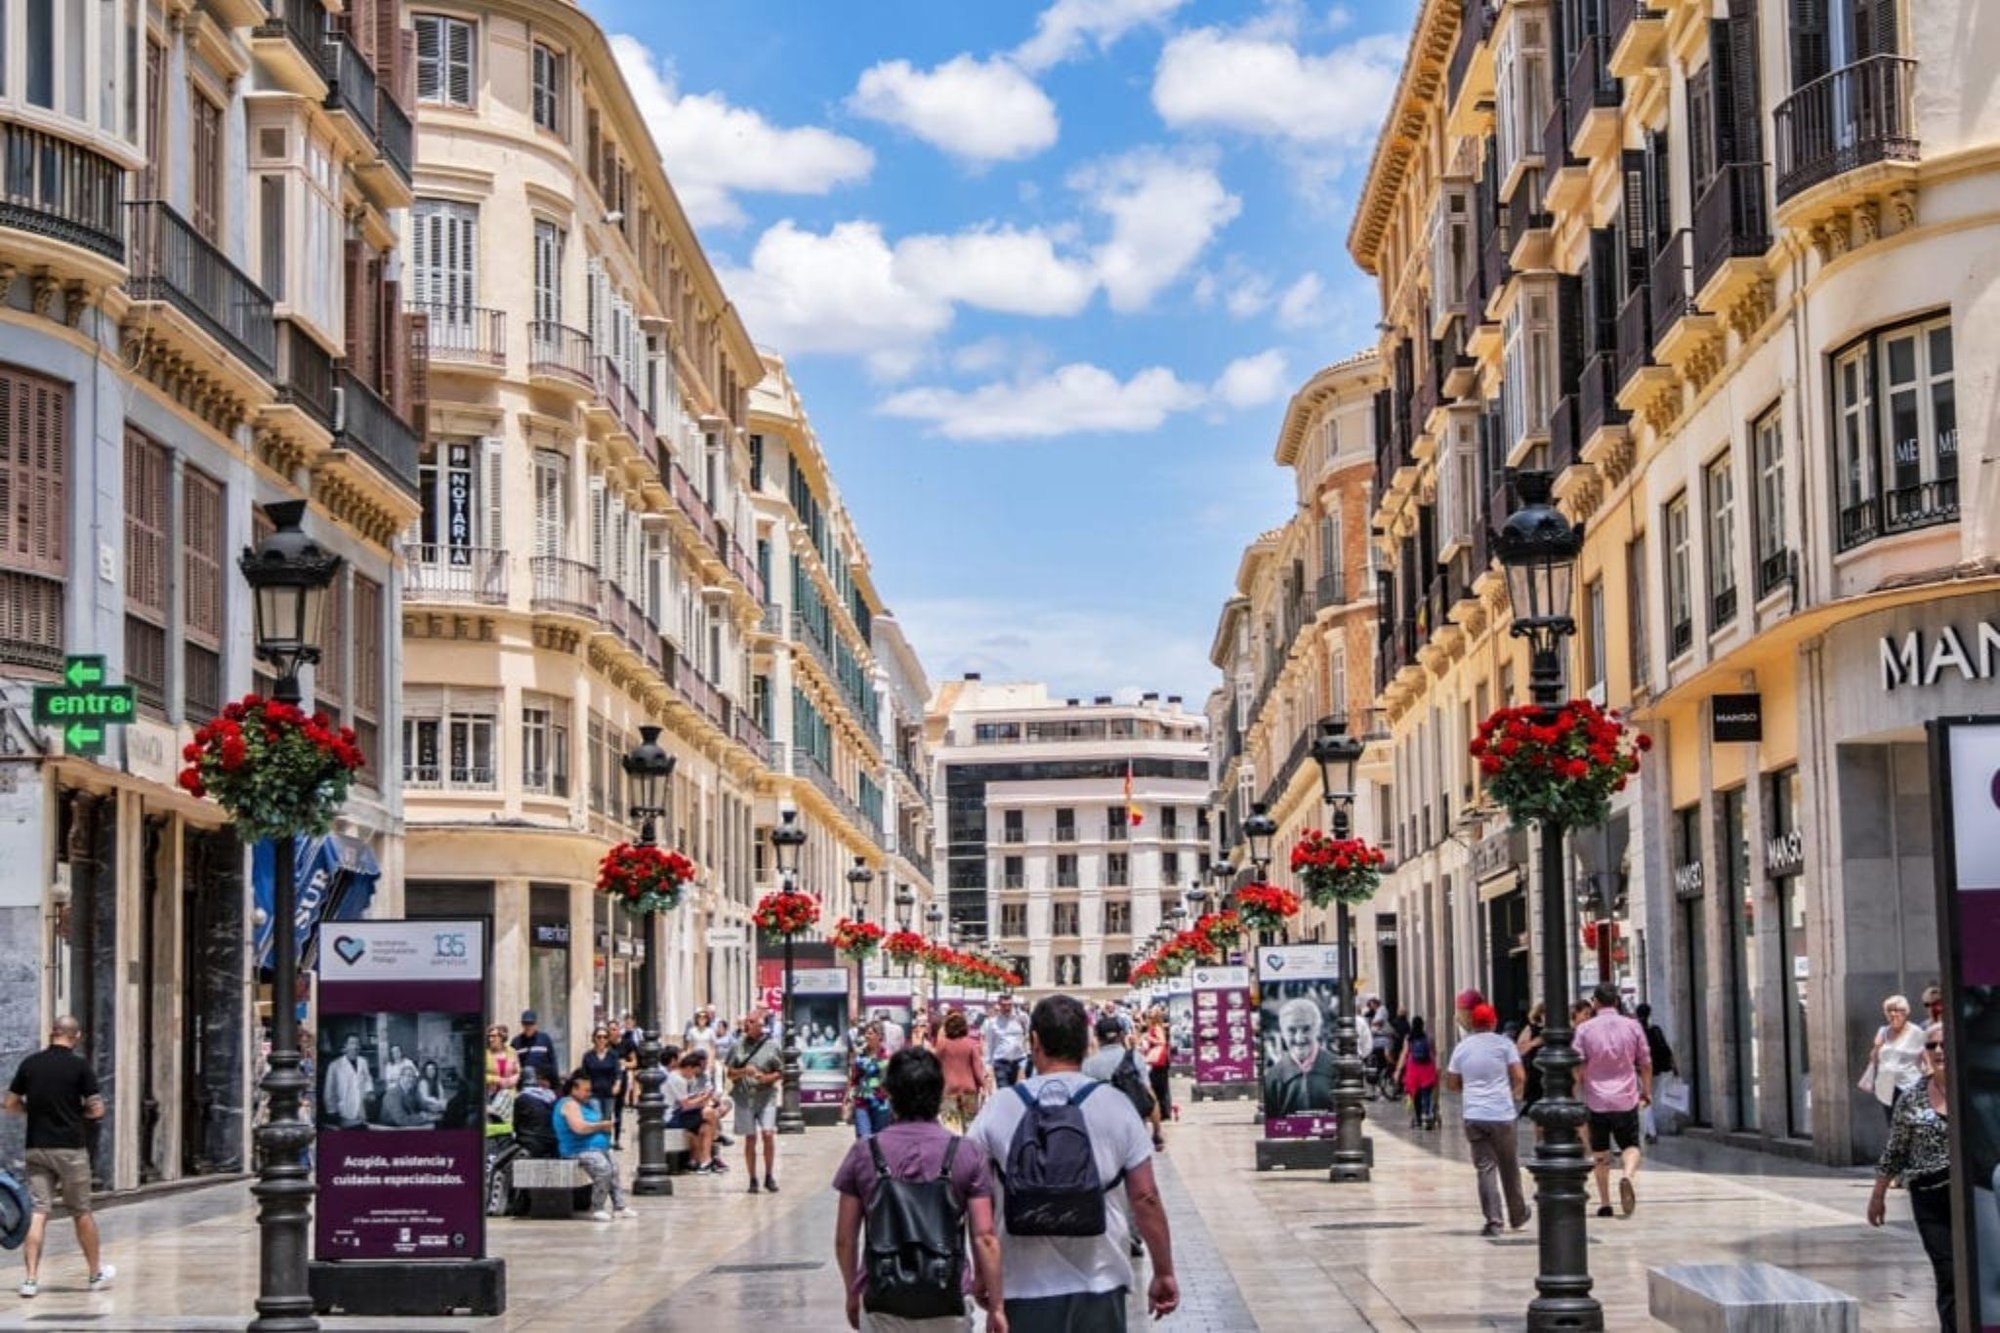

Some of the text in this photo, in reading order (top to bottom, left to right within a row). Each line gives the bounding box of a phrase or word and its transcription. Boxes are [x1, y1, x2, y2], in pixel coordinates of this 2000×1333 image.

[452, 473, 466, 563] NOTARIA
[1716, 713, 1758, 722] MANGO
[1767, 831, 1803, 869] MANGO
[1675, 861, 1702, 892] MANGO
[295, 868, 329, 930] SUR
[433, 933, 466, 957] 135
[344, 1155, 456, 1169] Acogida, asistencia y
[332, 1173, 465, 1187] cuidados especializados.
